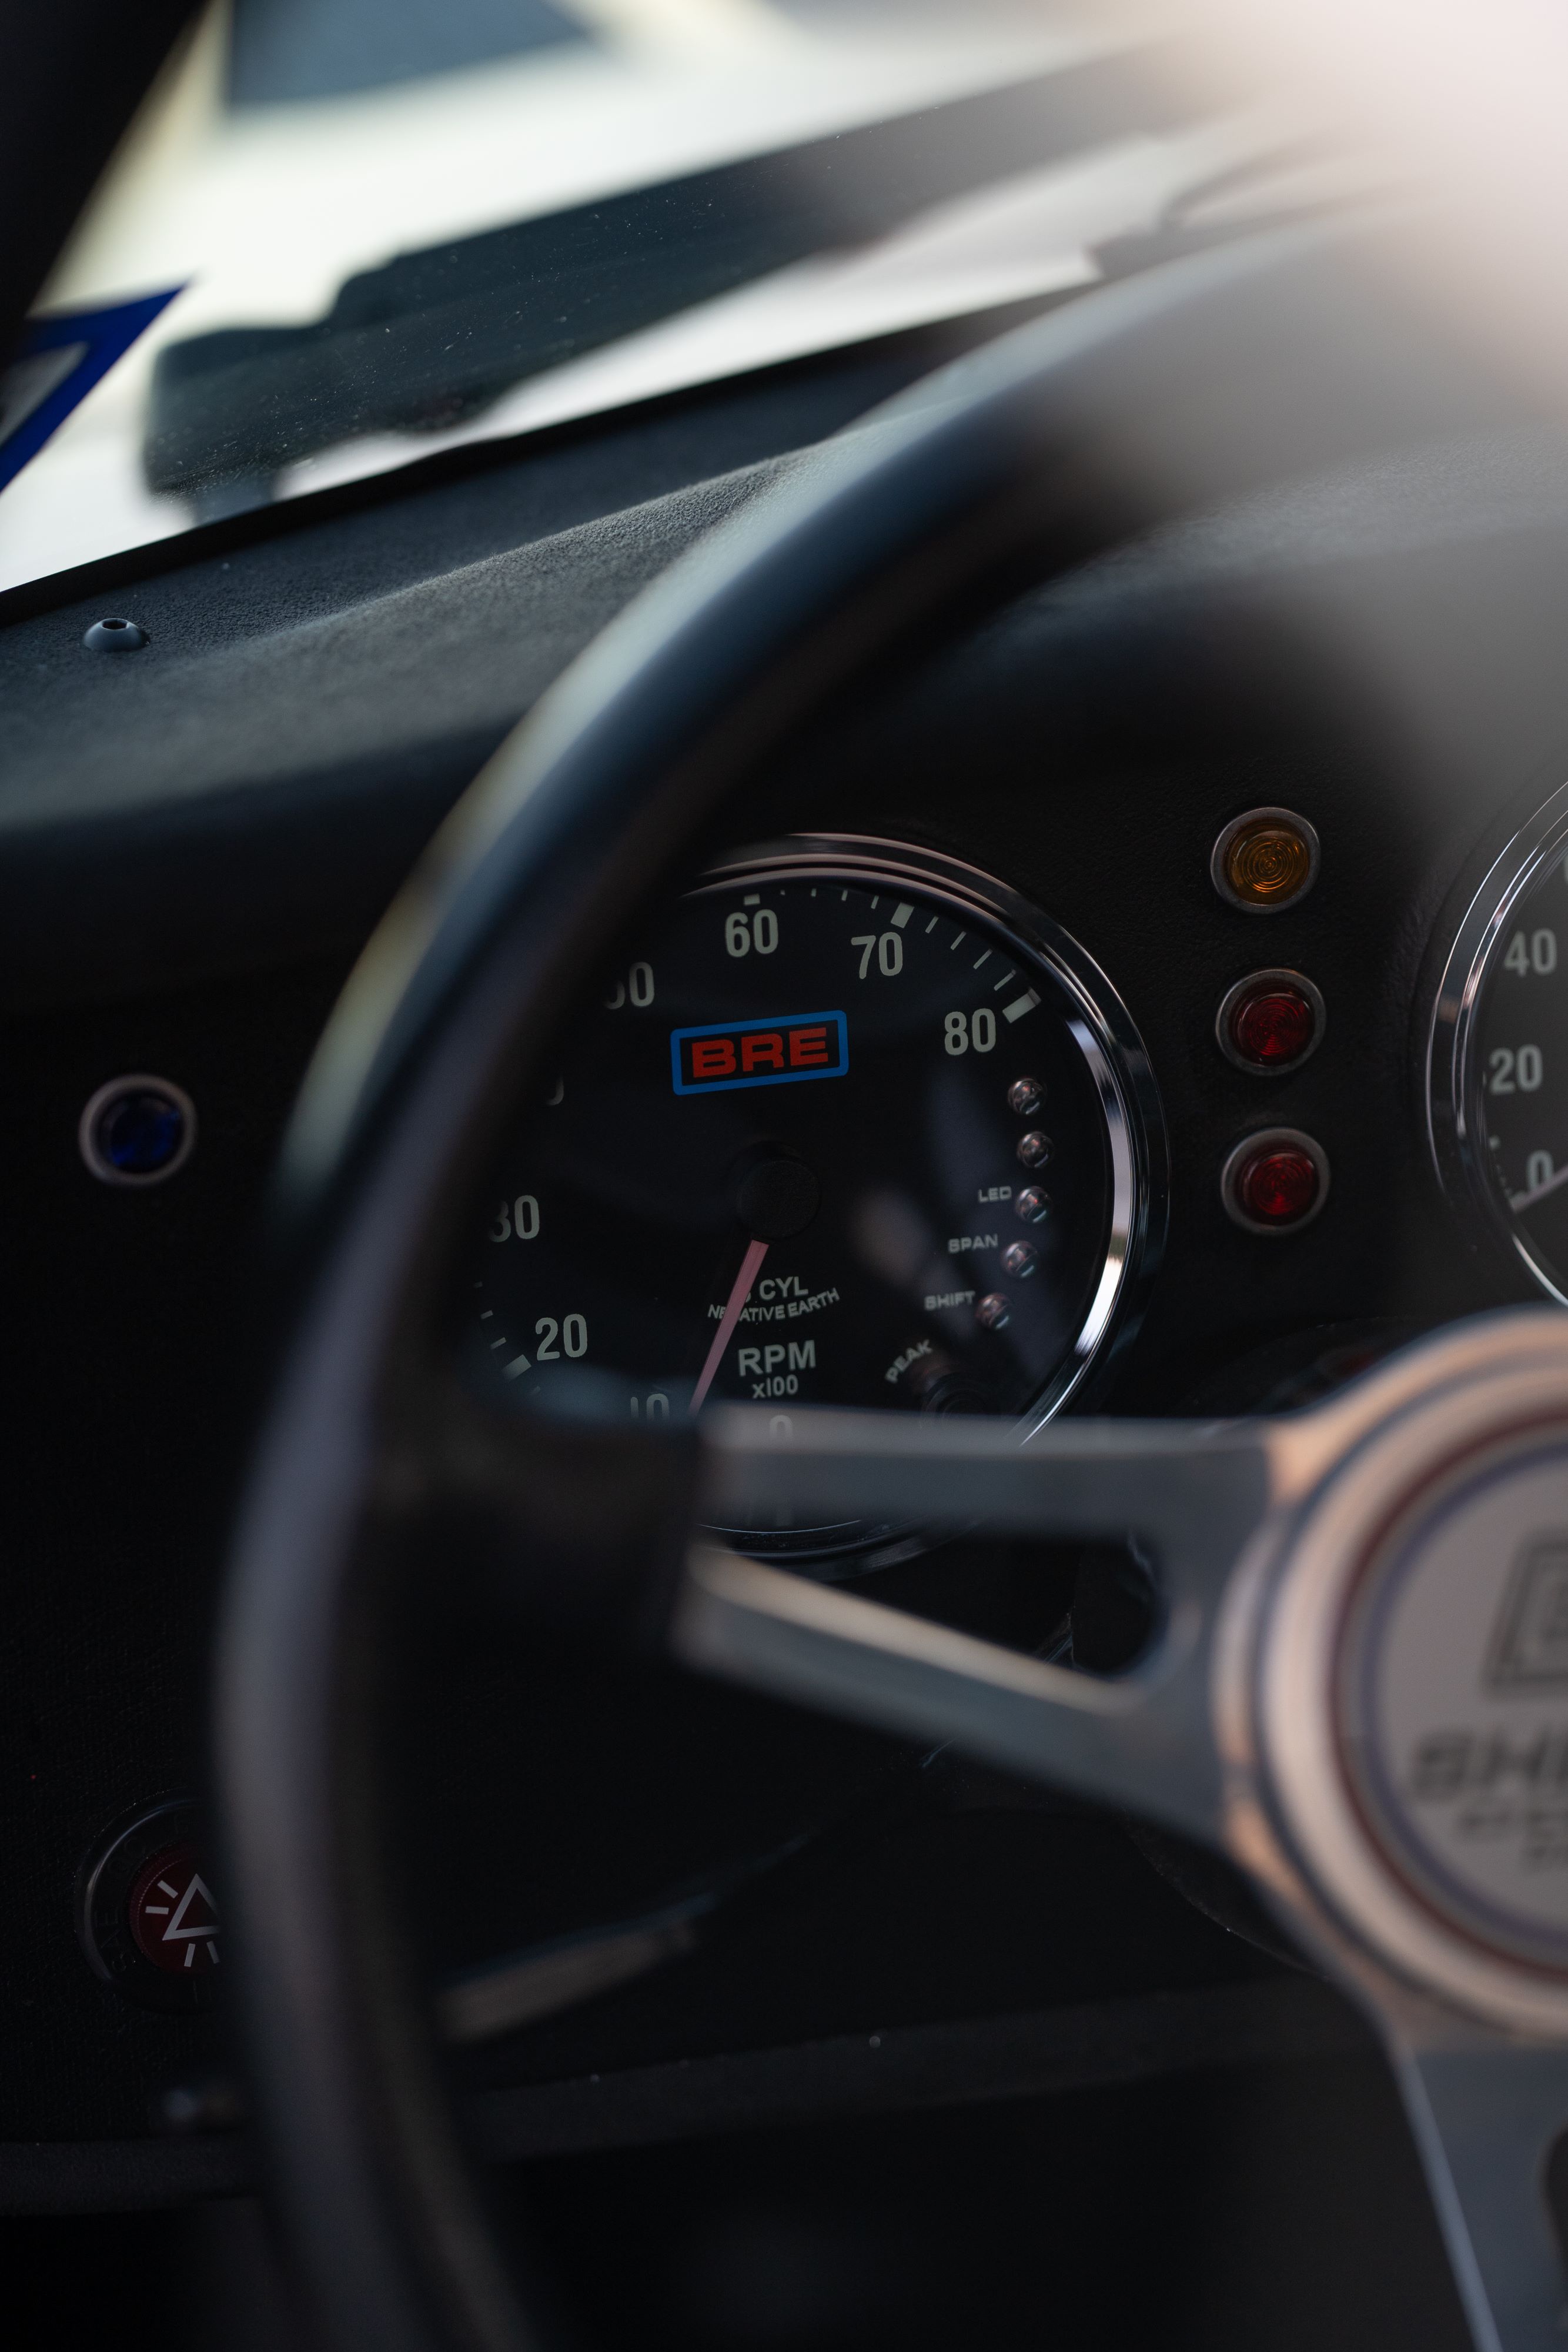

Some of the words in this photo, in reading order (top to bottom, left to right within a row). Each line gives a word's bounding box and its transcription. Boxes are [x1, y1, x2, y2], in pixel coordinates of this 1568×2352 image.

[725, 908, 778, 958] 60
[851, 931, 903, 980] 70
[1504, 928, 1557, 977] 40
[691, 1027, 828, 1078] BRE
[944, 1008, 997, 1056] 80
[1489, 1044, 1543, 1095] 20
[978, 1185, 1012, 1203] LED
[948, 1234, 998, 1254] SPAN
[707, 1304, 785, 1322] NEATIVE
[787, 1287, 841, 1319] EARTH
[759, 1276, 809, 1301] CYL
[924, 1291, 976, 1311] SHIFT
[535, 1314, 588, 1361] 20
[738, 1339, 816, 1377] RPM
[885, 1339, 933, 1384] PEAK
